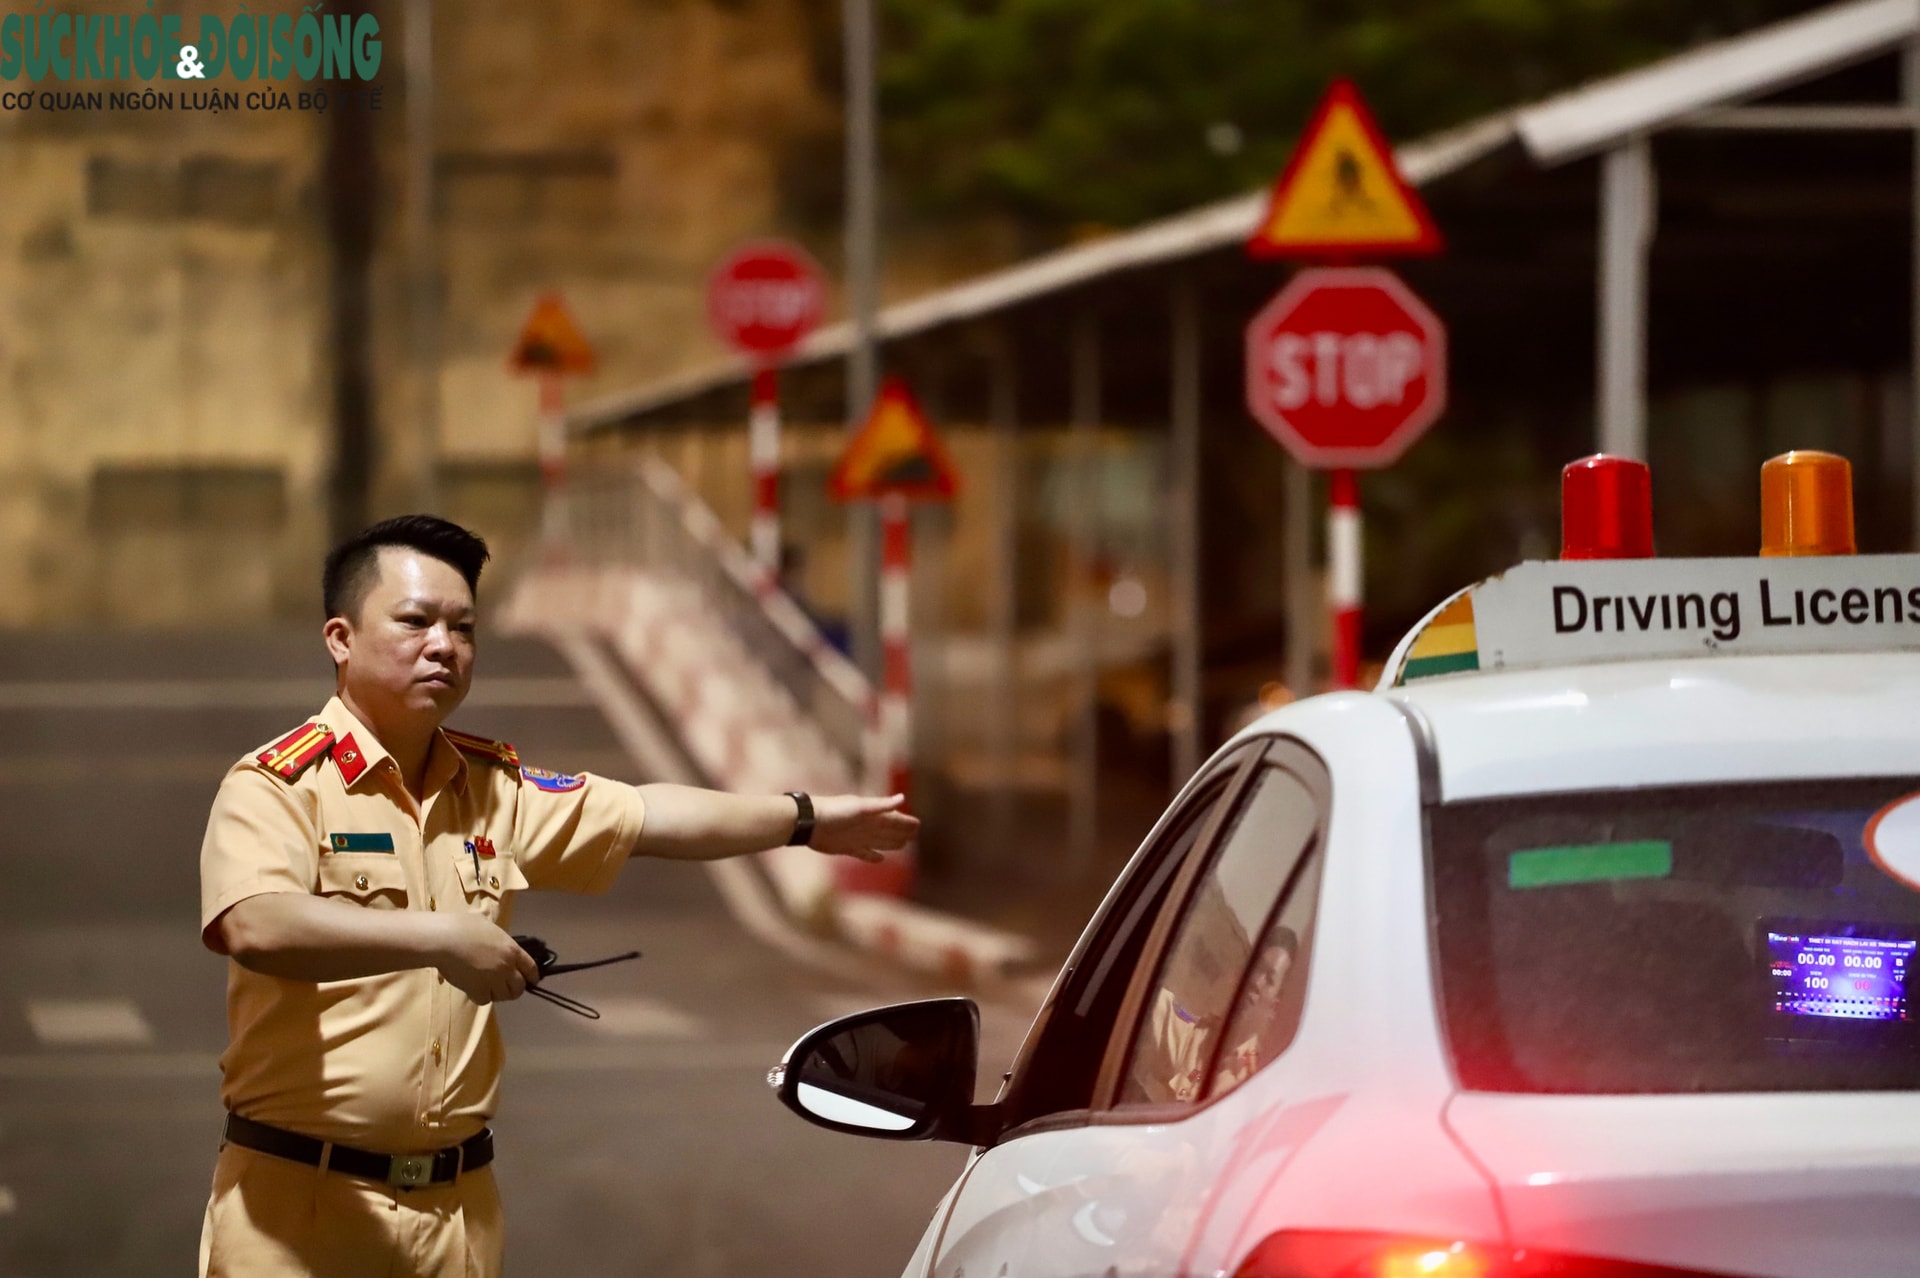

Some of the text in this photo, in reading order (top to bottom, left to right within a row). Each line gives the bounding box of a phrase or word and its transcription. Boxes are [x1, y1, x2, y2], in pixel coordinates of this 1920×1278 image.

[1268, 331, 1423, 410] STOP
[1553, 585, 1741, 641] Driving
[1798, 953, 1836, 966] 00.00
[1843, 955, 1882, 969] 00.00
[1803, 976, 1829, 989] 100
